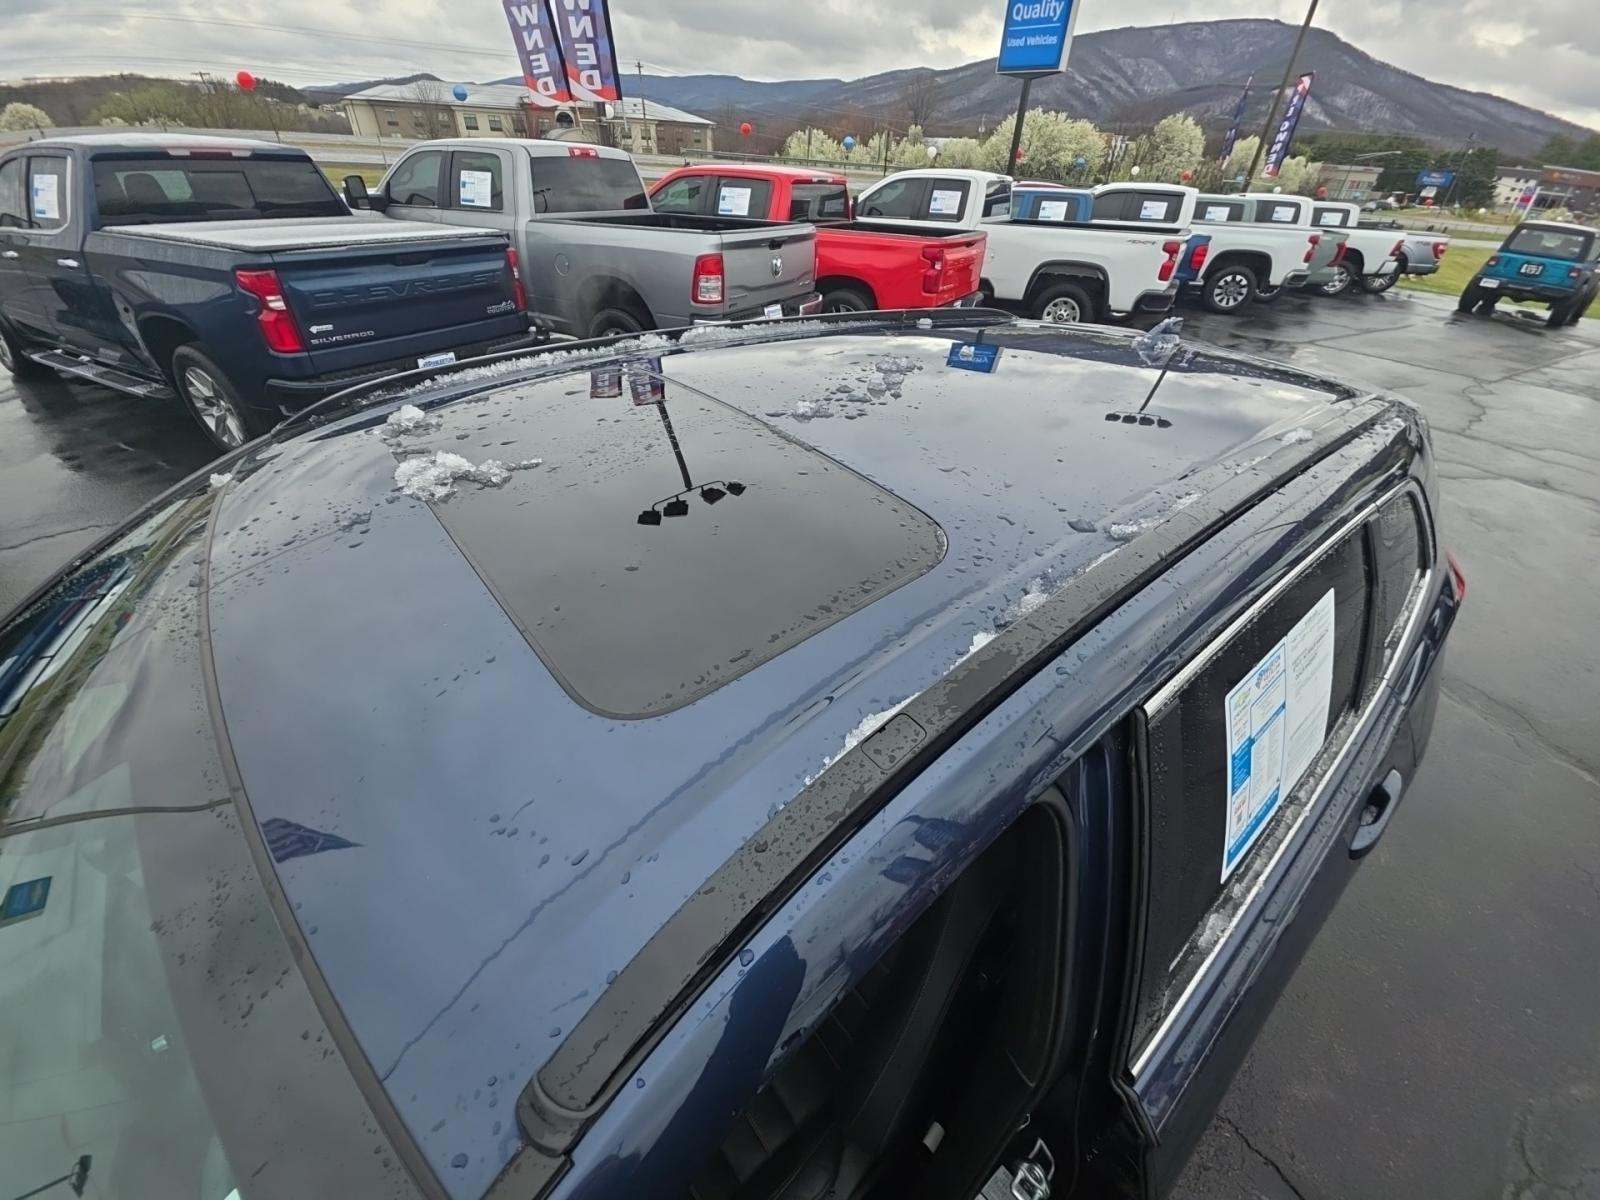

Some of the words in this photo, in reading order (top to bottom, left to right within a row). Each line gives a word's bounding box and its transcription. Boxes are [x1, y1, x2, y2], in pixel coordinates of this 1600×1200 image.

[1012, 0, 1064, 21] Quality
[1007, 36, 1025, 47] Used
[1026, 34, 1058, 46] Vehicles
[310, 330, 375, 345] SILVERADO
